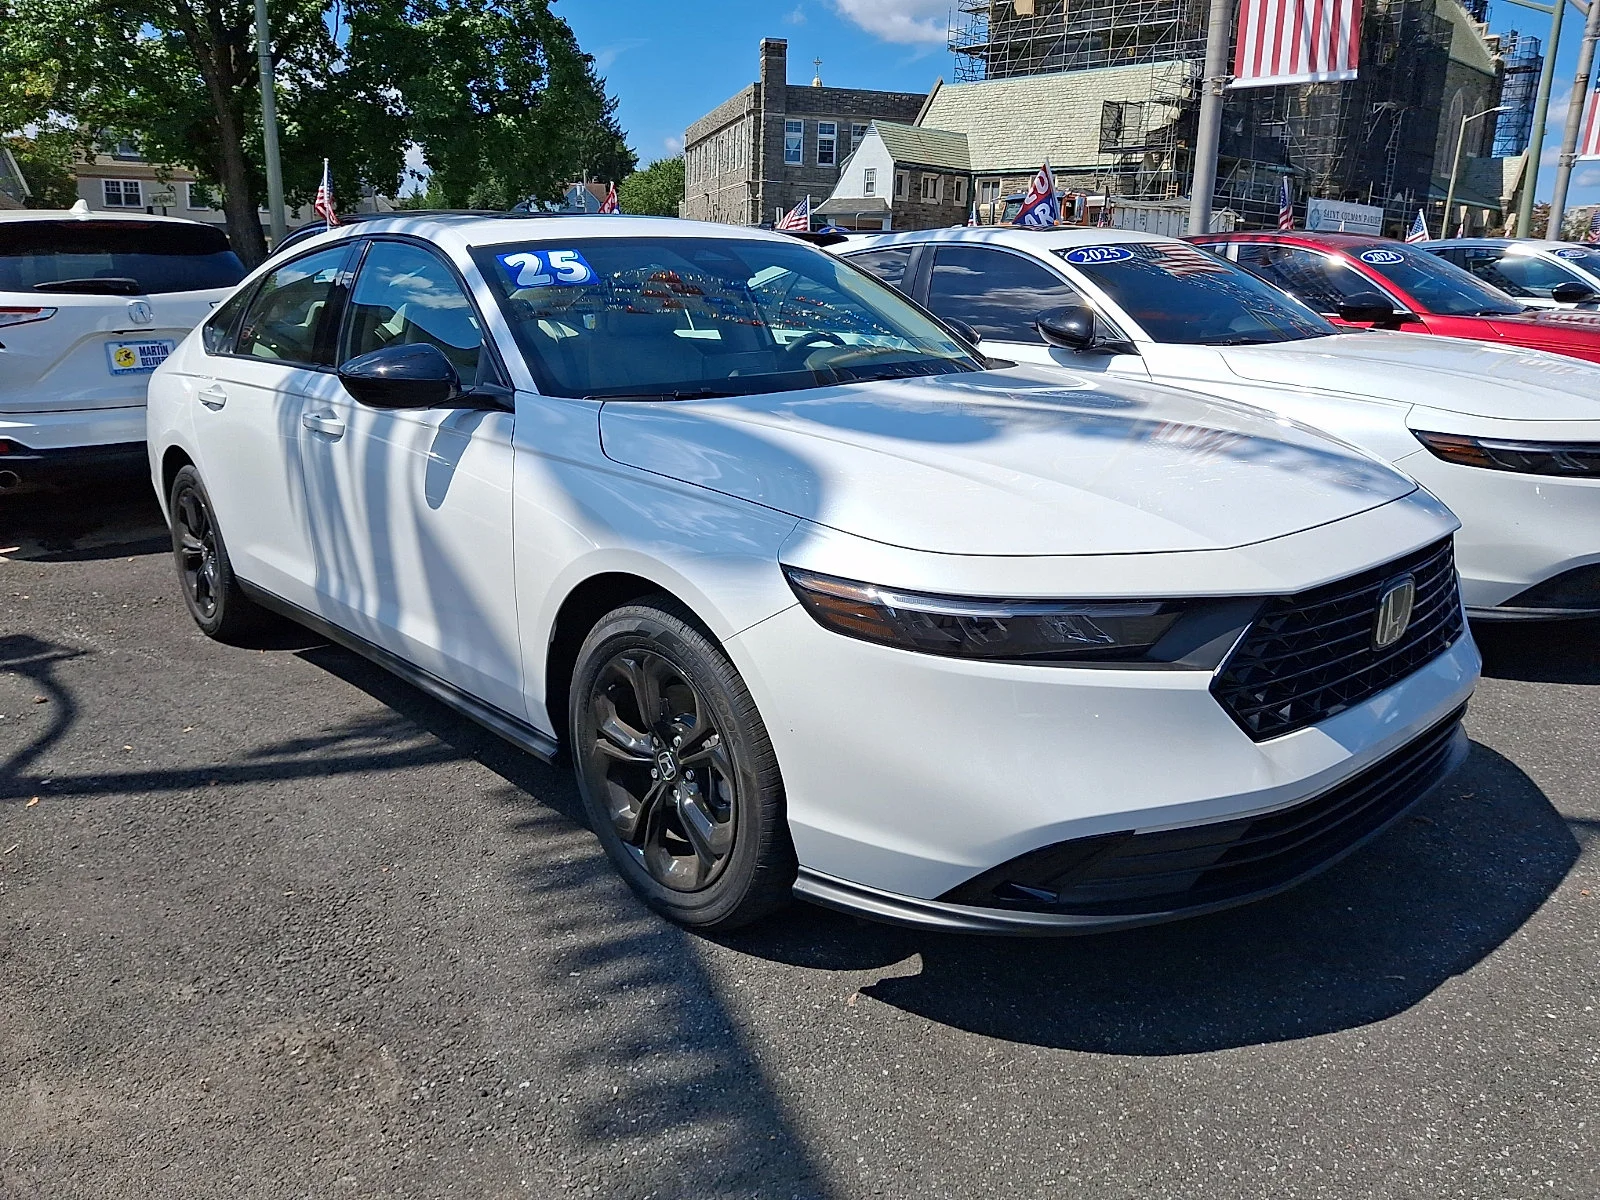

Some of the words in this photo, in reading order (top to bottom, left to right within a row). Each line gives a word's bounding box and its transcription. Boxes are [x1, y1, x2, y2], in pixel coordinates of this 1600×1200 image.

[1323, 208, 1340, 220] SAINT
[1076, 247, 1121, 263] 2025
[1367, 252, 1398, 262] 2024
[503, 251, 591, 287] 25
[138, 344, 170, 357] MARTIN
